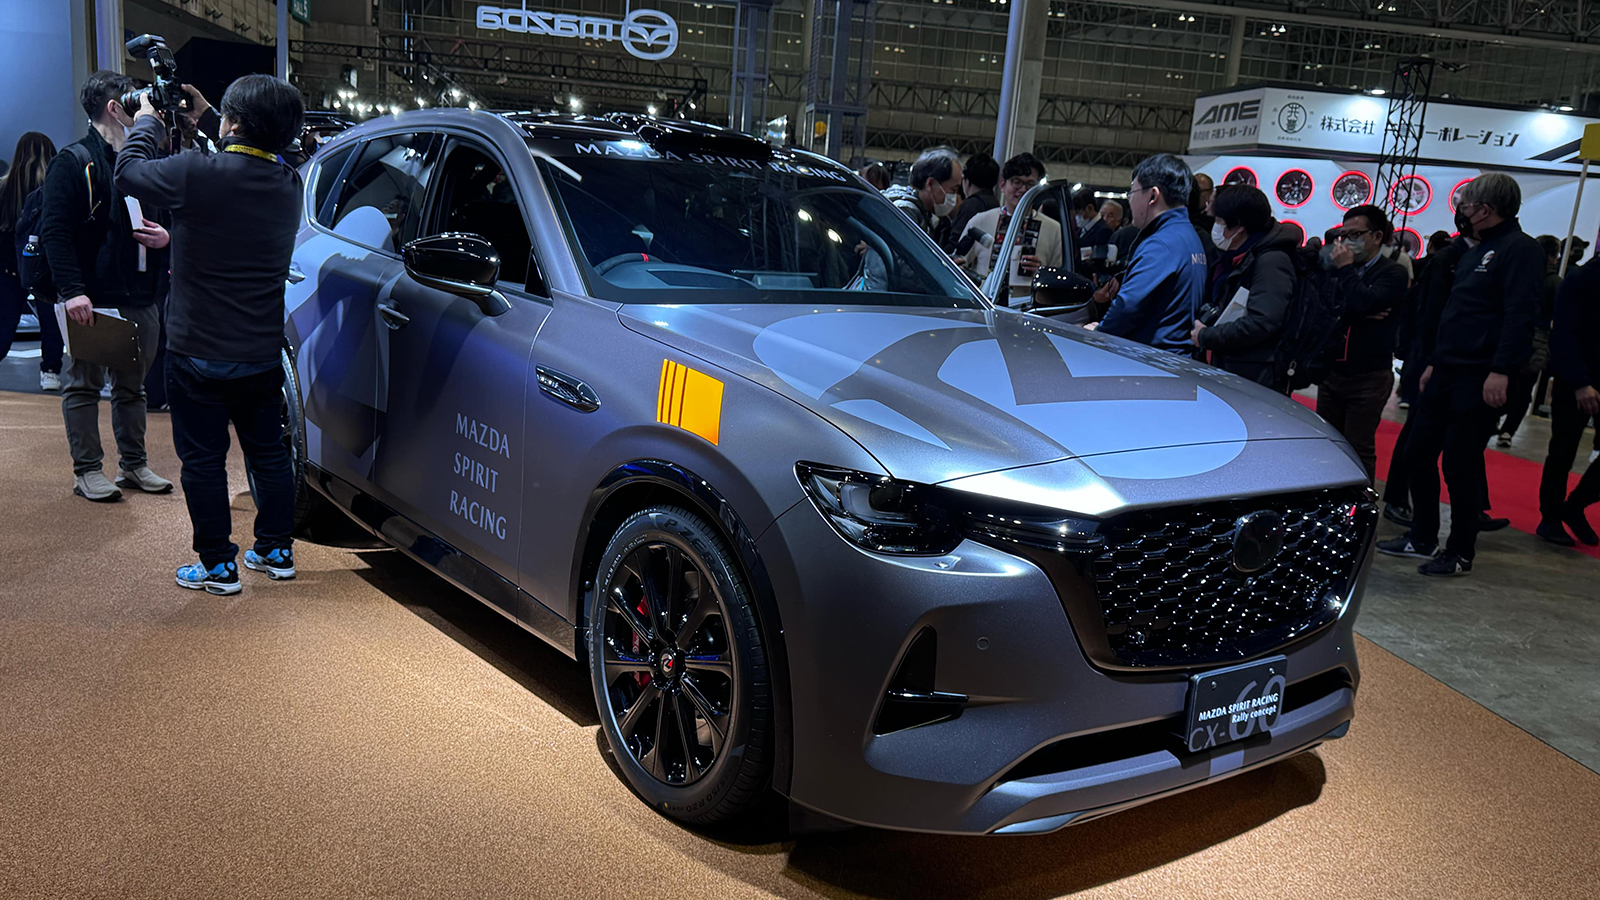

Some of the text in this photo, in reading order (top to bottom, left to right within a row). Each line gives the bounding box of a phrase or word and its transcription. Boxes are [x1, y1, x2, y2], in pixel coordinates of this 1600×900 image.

[1194, 99, 1261, 126] AME
[1319, 115, 1376, 136] 株式会社
[574, 142, 847, 183] MAZDA SPIRIT RACING
[455, 412, 511, 459] MAZDA
[453, 451, 499, 494] SPIRIT
[449, 489, 507, 541] RACING
[1188, 675, 1287, 753] CX-60
[1198, 692, 1280, 722] MAZDA SPIRIT RACING
[1231, 705, 1278, 724] Rally concept
